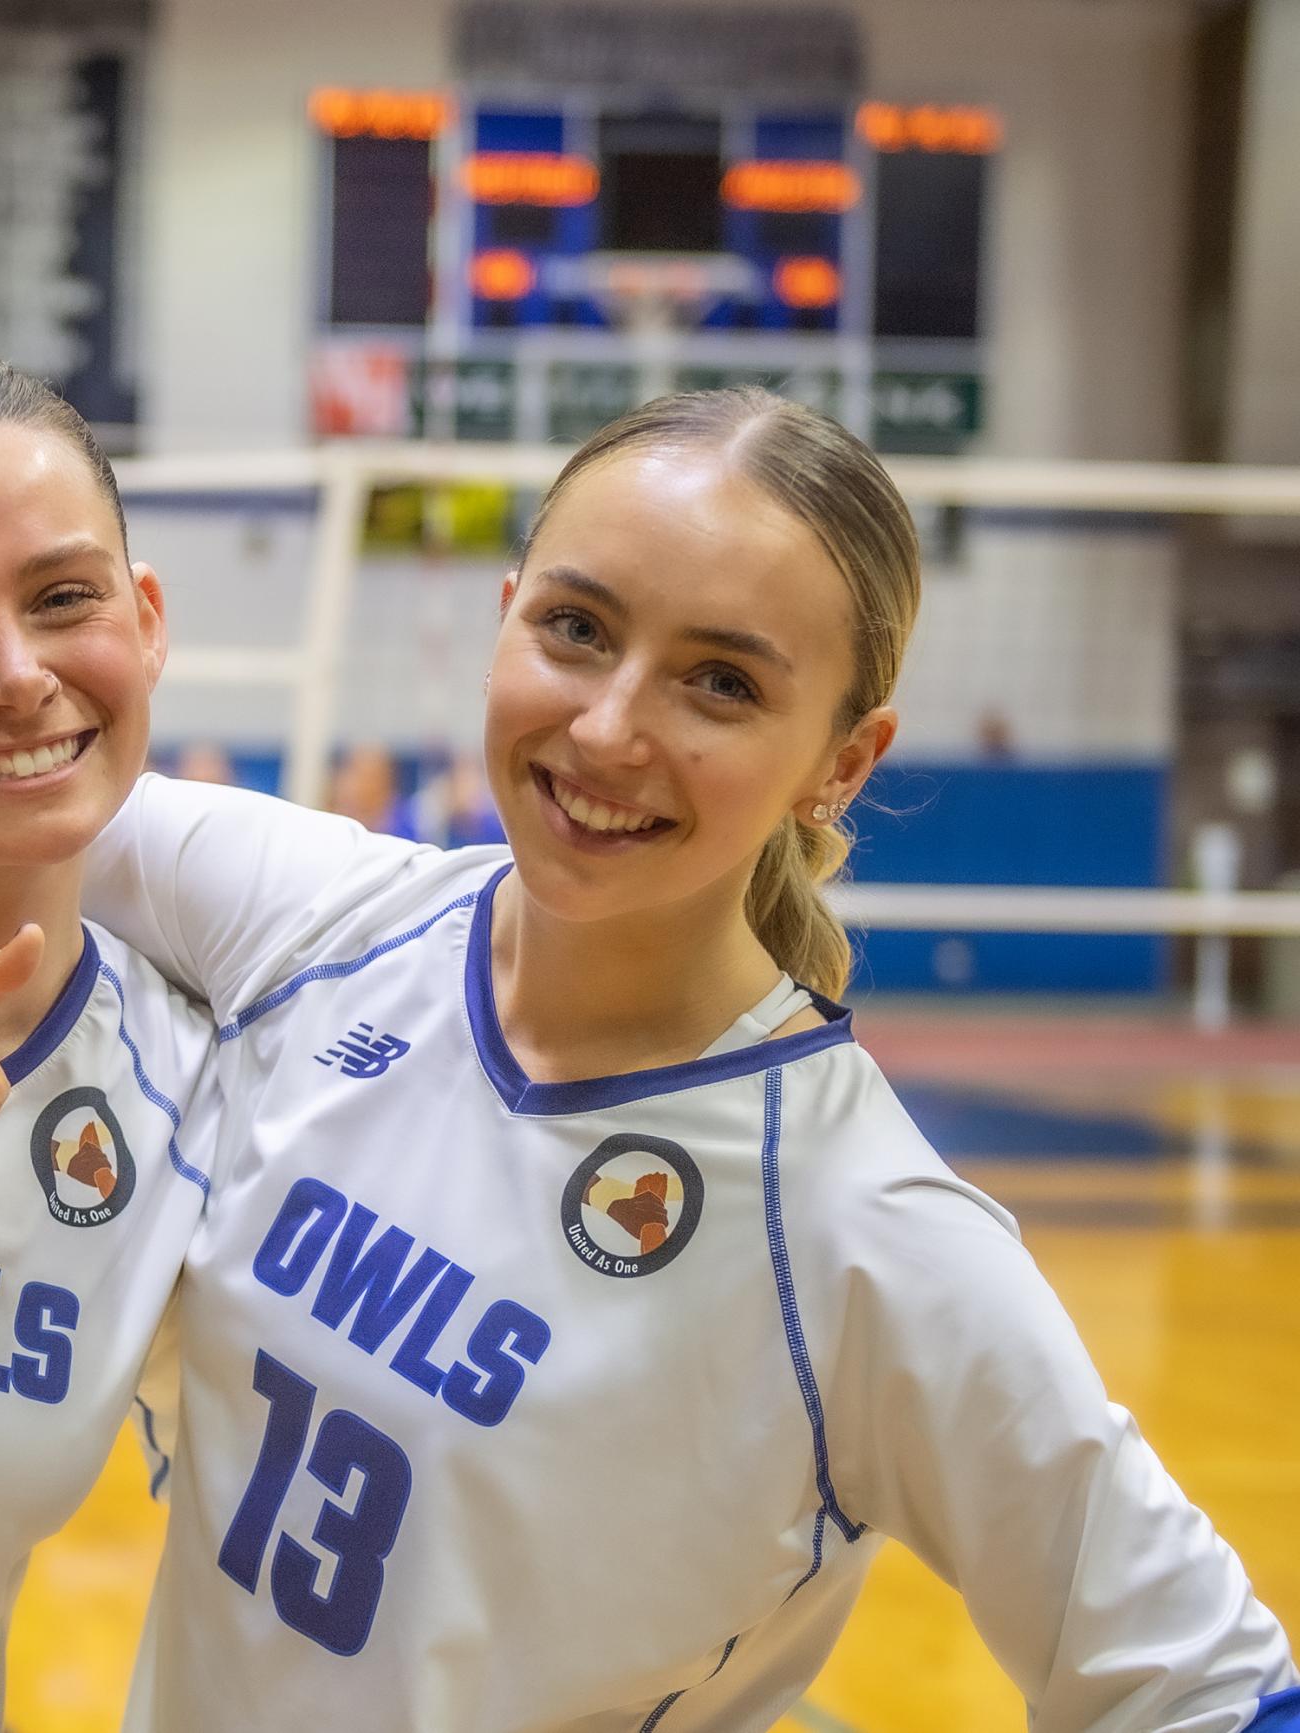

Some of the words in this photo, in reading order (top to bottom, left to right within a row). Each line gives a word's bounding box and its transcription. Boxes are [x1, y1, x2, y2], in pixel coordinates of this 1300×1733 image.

[49, 1191, 71, 1221] United
[73, 1210, 88, 1224] As
[90, 1207, 112, 1222] One
[568, 1223, 598, 1260] United
[595, 1254, 611, 1270] As
[615, 1260, 638, 1274] One
[252, 1176, 552, 1427] OWLS
[217, 1347, 413, 1657] 13
